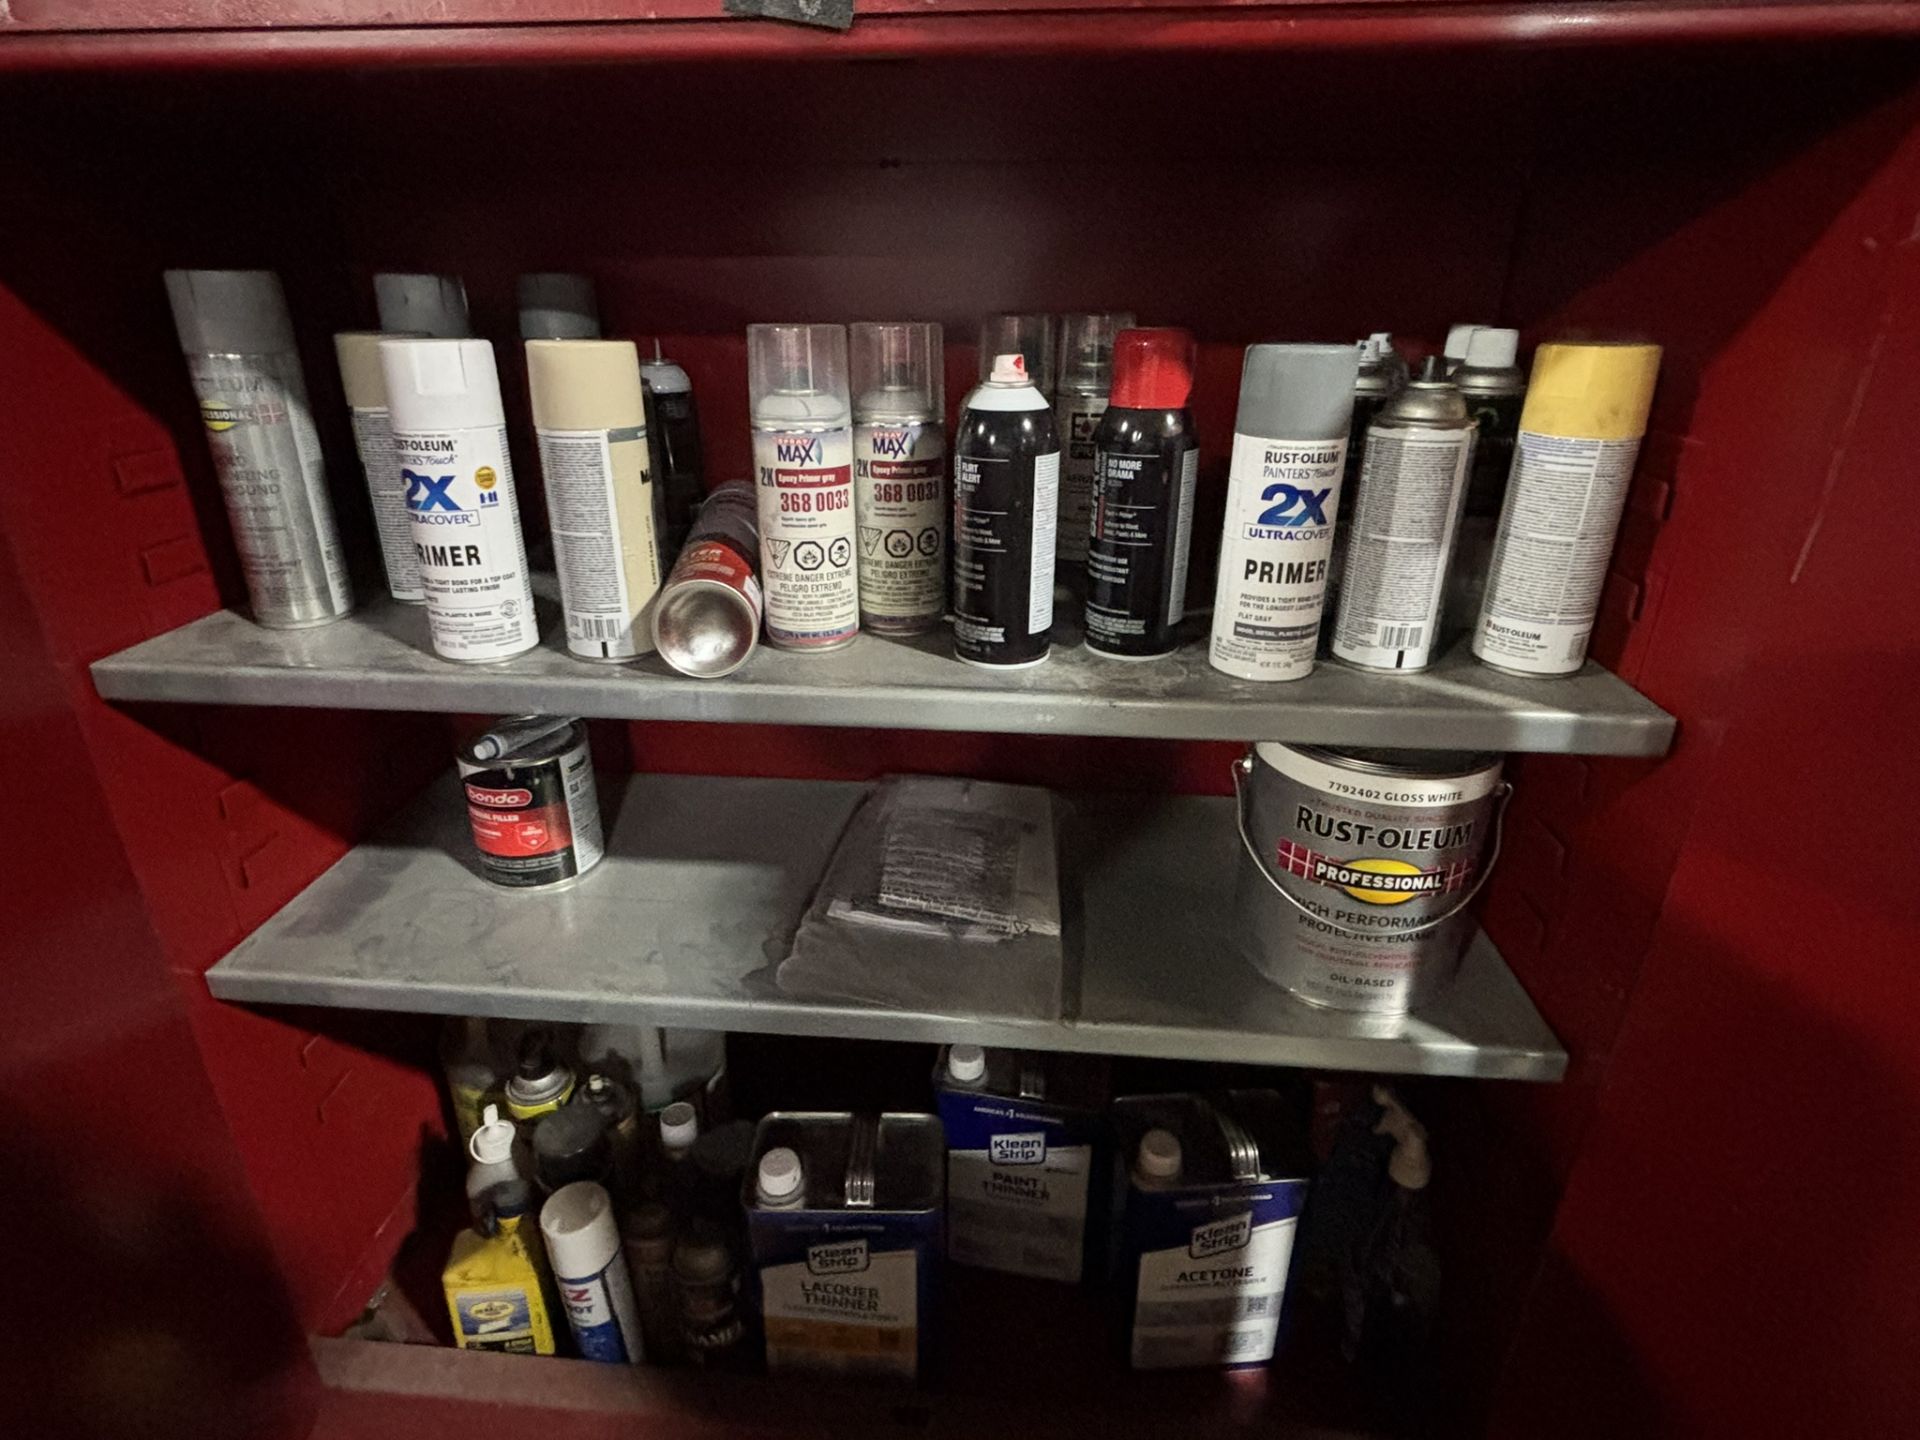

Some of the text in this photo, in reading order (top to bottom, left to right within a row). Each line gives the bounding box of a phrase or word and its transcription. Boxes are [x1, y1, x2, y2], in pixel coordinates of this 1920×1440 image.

[777, 438, 817, 468] MAX
[873, 432, 909, 459] MAX
[857, 459, 869, 479] 2K
[1119, 460, 1142, 471] MORE
[761, 466, 775, 487] 2K
[401, 468, 463, 511] 2X
[875, 483, 903, 502] 368
[780, 492, 812, 512] 368
[816, 489, 850, 512] 0033
[1257, 483, 1332, 526] 2X
[416, 544, 481, 567] RIMER
[795, 573, 825, 583] DANGER
[1244, 558, 1327, 585] PRIMER
[780, 583, 809, 593] PELIGRO
[1239, 600, 1251, 608] FOR
[1238, 612, 1253, 620] FLAT
[468, 787, 519, 804] bondo
[1328, 781, 1463, 804] 7792402 GLOSS WHITE
[1296, 804, 1474, 850] RUST-OLEUM
[1315, 862, 1443, 890] PROFESSIONAL
[1329, 973, 1395, 988] OIL-BASED
[994, 1139, 1041, 1150] Klean
[999, 1149, 1036, 1160] Strip
[993, 1172, 1038, 1189] PAINT
[1196, 1221, 1247, 1242] Klean
[1200, 1234, 1240, 1249] Strip
[811, 1246, 864, 1262] Klean
[818, 1257, 859, 1269] Strip
[1177, 1266, 1255, 1283] ACETONE
[801, 1281, 880, 1301] LACQUER
[803, 1293, 881, 1313] THINNER
